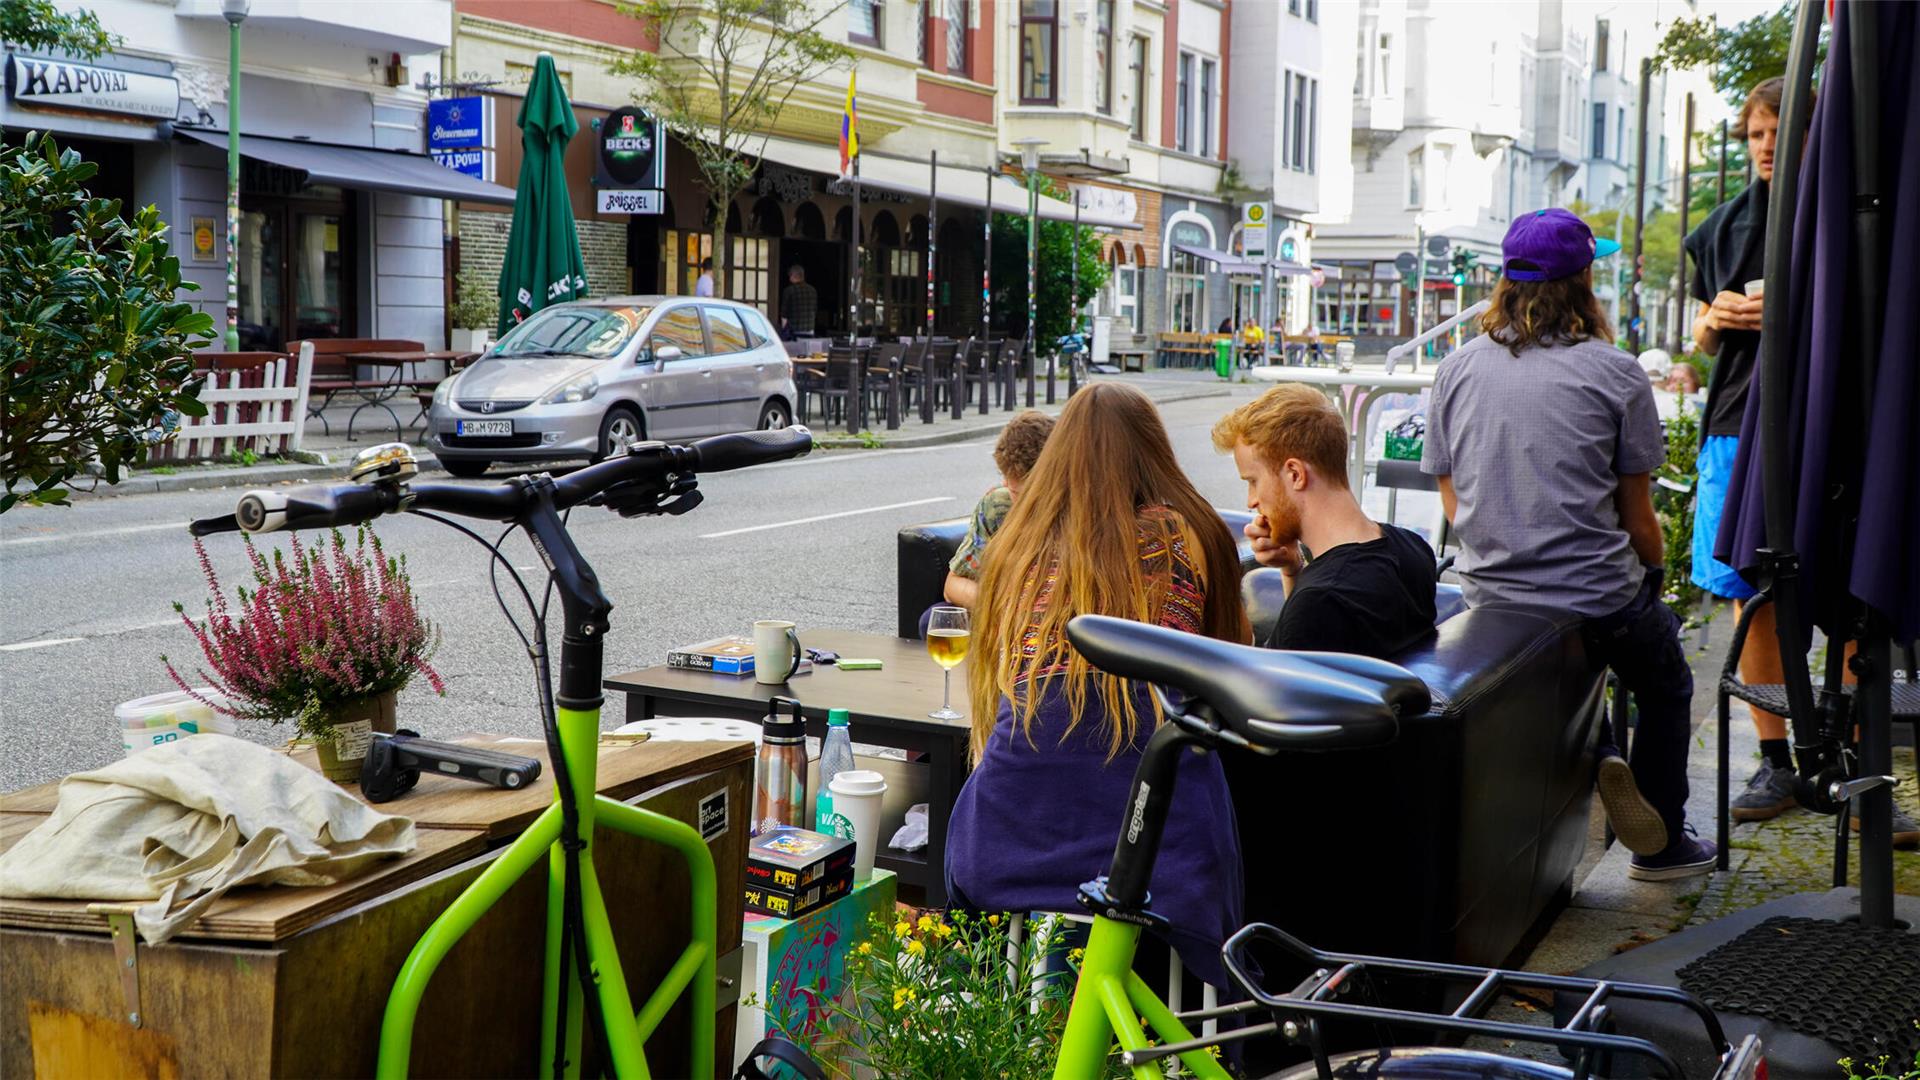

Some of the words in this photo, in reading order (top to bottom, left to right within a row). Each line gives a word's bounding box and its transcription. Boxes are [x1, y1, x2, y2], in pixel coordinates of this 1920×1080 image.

[18, 60, 128, 96] KAPOVAZ
[606, 138, 651, 150] BECK'S
[433, 153, 480, 169] KAPOVAZ
[605, 192, 648, 211] RÜSSEL
[462, 421, 475, 434] HB
[479, 421, 486, 433] M
[486, 420, 510, 433] 9728
[152, 732, 178, 746] 20
[702, 805, 712, 817] art
[1128, 781, 1150, 844] ergotec
